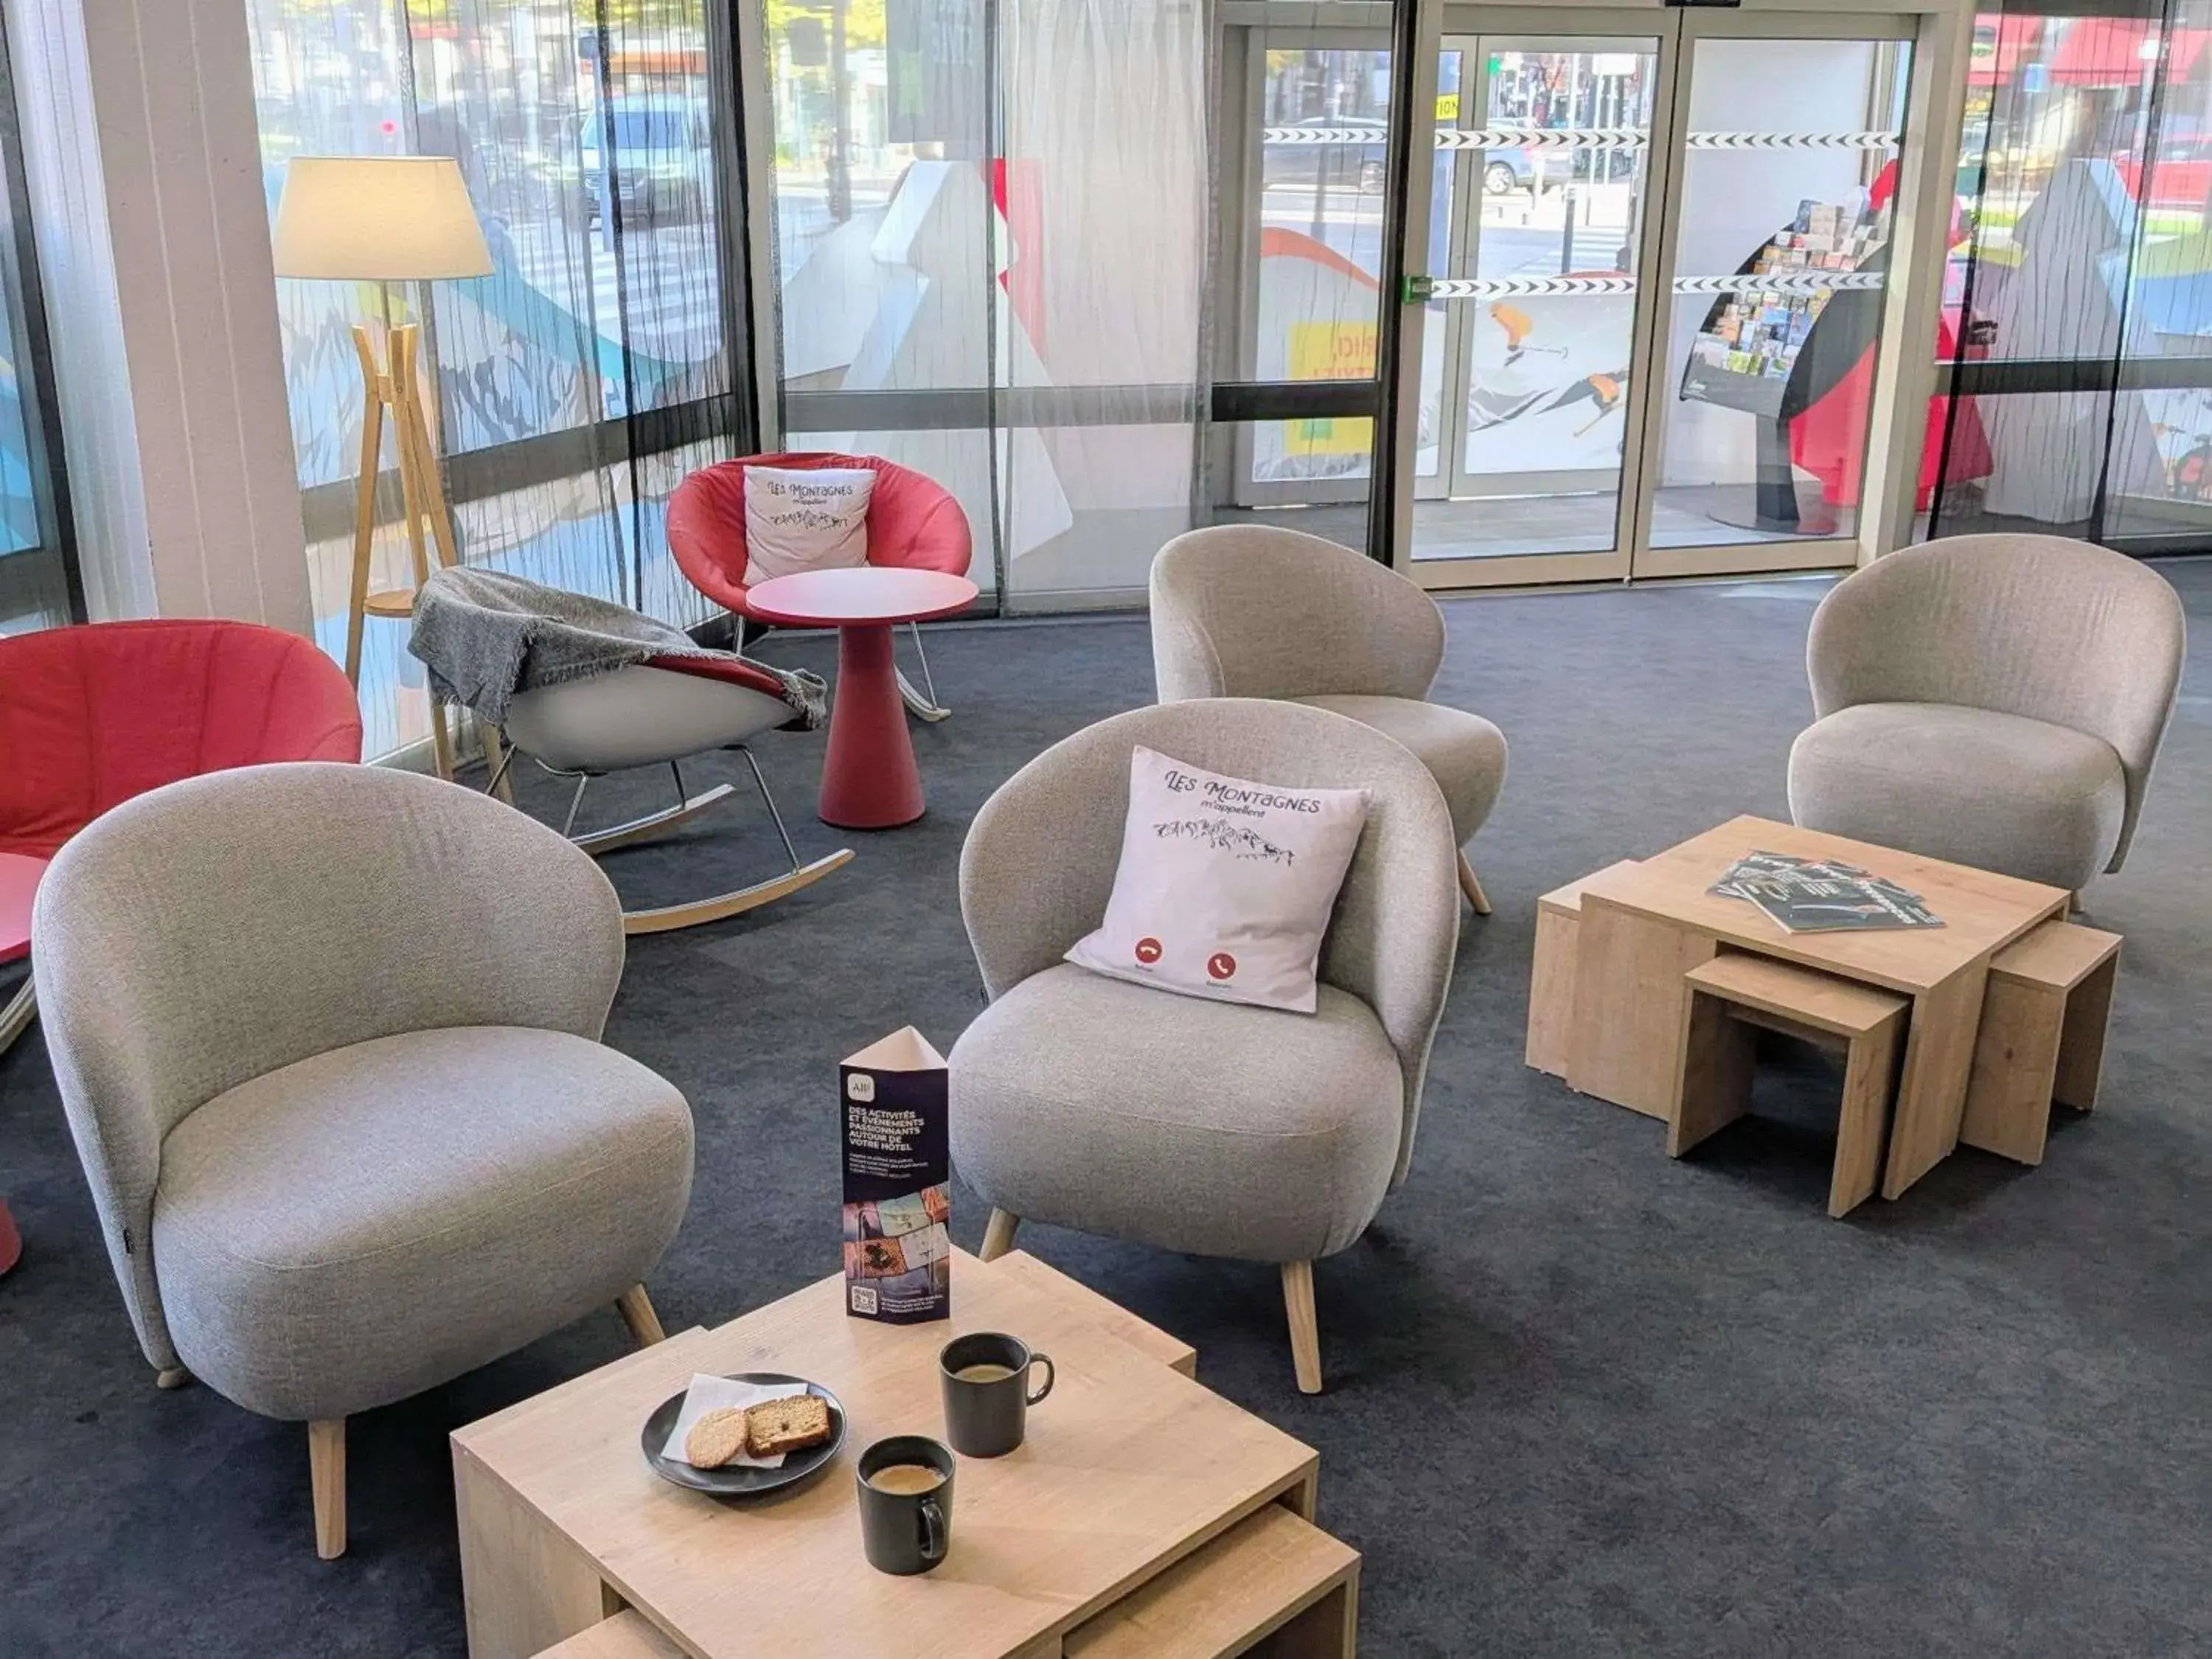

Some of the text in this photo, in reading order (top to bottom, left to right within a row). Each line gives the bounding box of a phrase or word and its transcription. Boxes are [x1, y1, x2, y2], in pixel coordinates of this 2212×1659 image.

[768, 481, 786, 495] LES
[1165, 771, 1197, 793] LES
[1200, 799, 1266, 818] m'appellent
[849, 1105, 916, 1120] DES ACTIVITÉS
[849, 1121, 921, 1135] PASSIONNANTS
[849, 1130, 902, 1144] AUTOUR DE
[849, 1138, 880, 1149] VOTRE
